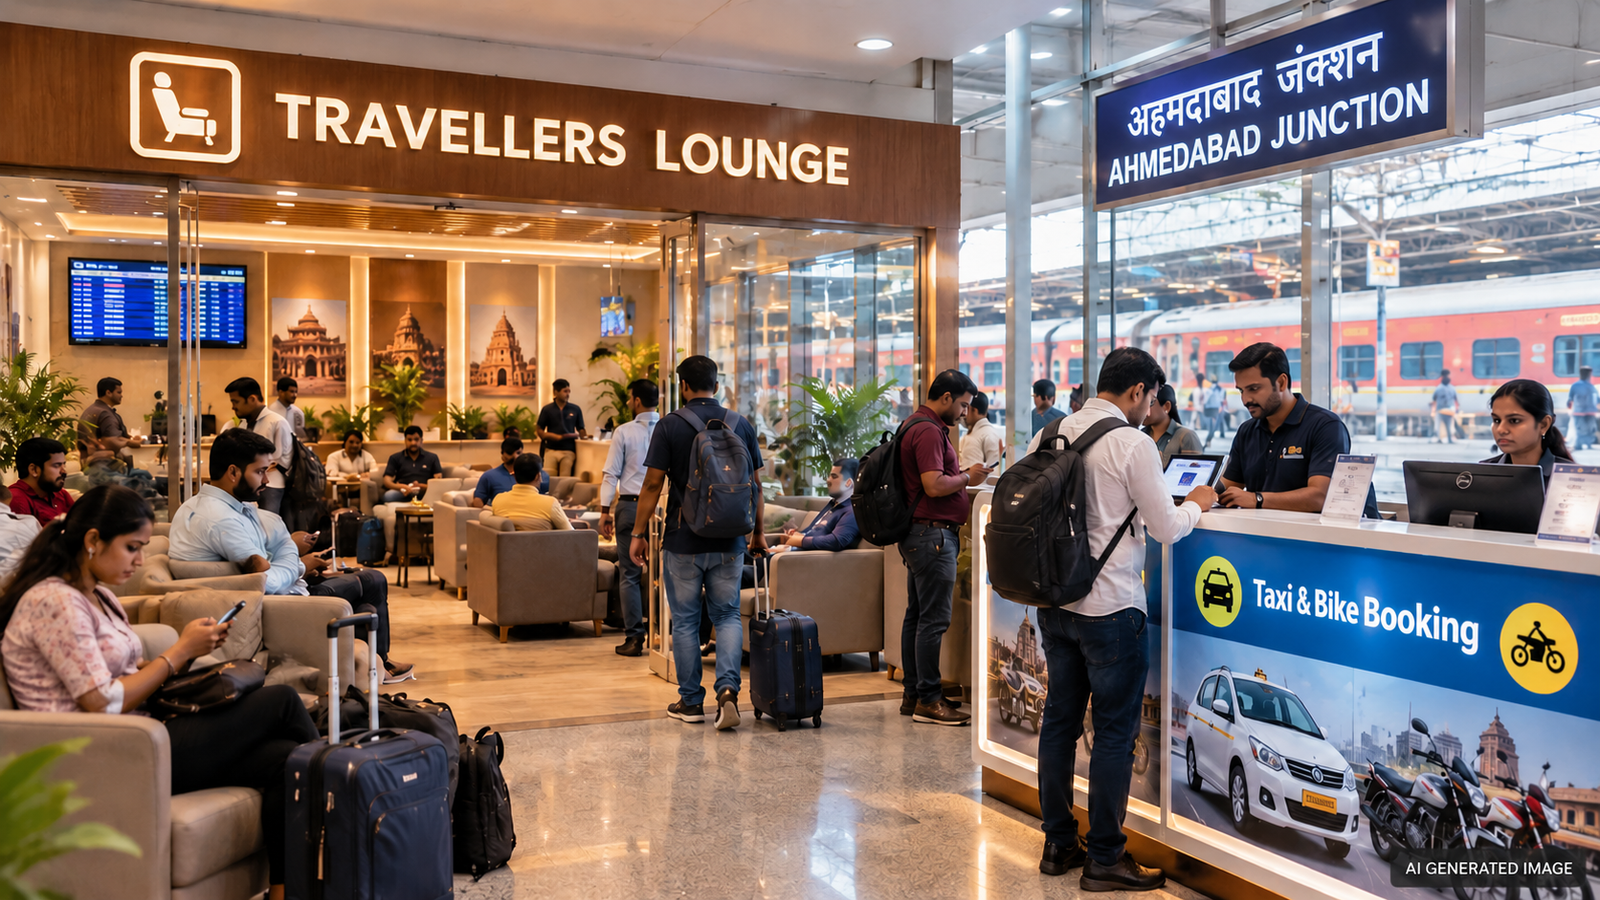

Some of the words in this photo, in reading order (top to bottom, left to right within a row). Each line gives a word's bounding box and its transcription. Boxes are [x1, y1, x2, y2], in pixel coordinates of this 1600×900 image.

[1108, 124, 1262, 188] AHMEDABAD
[1270, 78, 1430, 150] JUNCTION
[1127, 69, 1263, 137] अहमदाबाद
[1276, 31, 1384, 94] जंक्शन
[275, 92, 627, 168] TRAVELLERS
[656, 128, 850, 186] LOUNGE
[1253, 578, 1293, 613] Taxi
[1296, 586, 1312, 616] &
[1314, 588, 1360, 625] Bike
[1363, 596, 1480, 656] Booking
